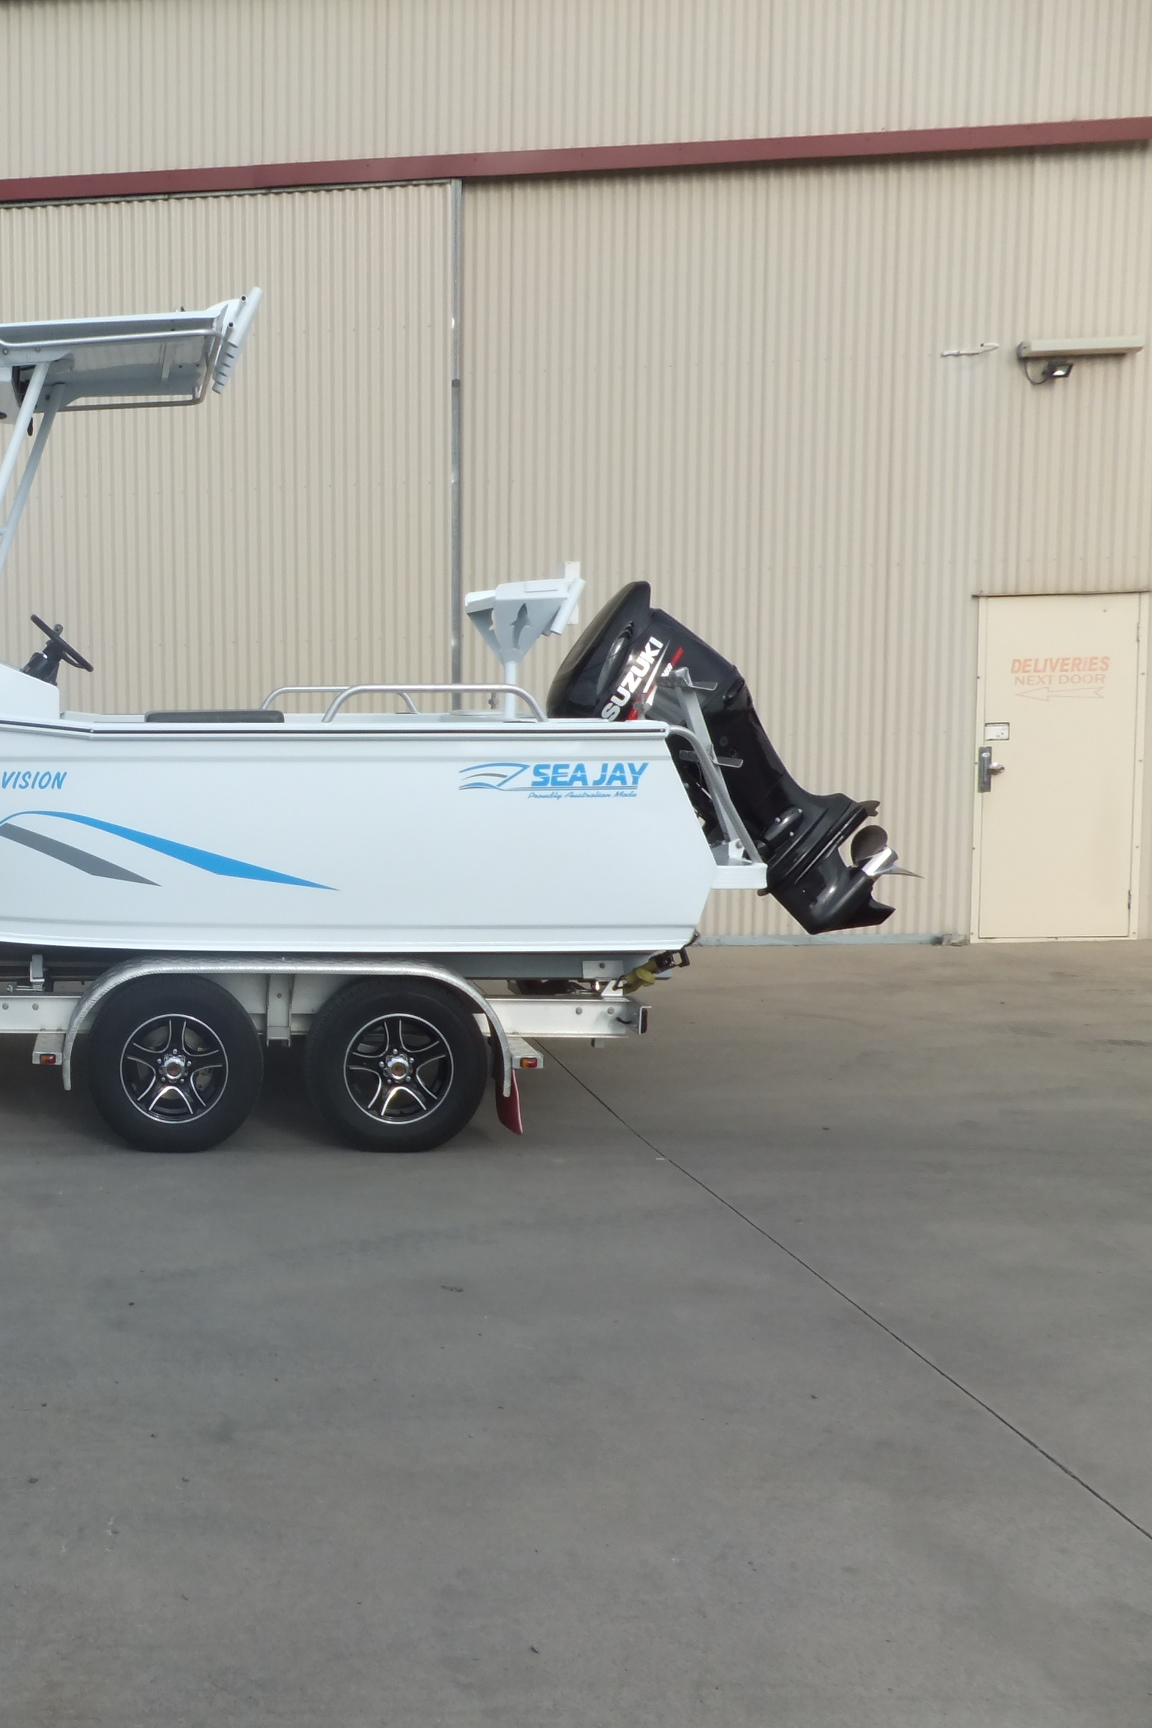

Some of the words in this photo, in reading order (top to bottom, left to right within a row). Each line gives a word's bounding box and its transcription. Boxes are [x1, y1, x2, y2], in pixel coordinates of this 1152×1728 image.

[1010, 656, 1110, 674] DELIVERIES
[601, 636, 664, 721] SUZUKI
[1014, 674, 1054, 685] NEXT
[1058, 674, 1106, 685] DOOR
[1, 770, 68, 790] VISION
[531, 763, 588, 786] SEA
[592, 762, 649, 786] JAY
[528, 791, 563, 800] Proudly
[612, 790, 638, 798] Made
